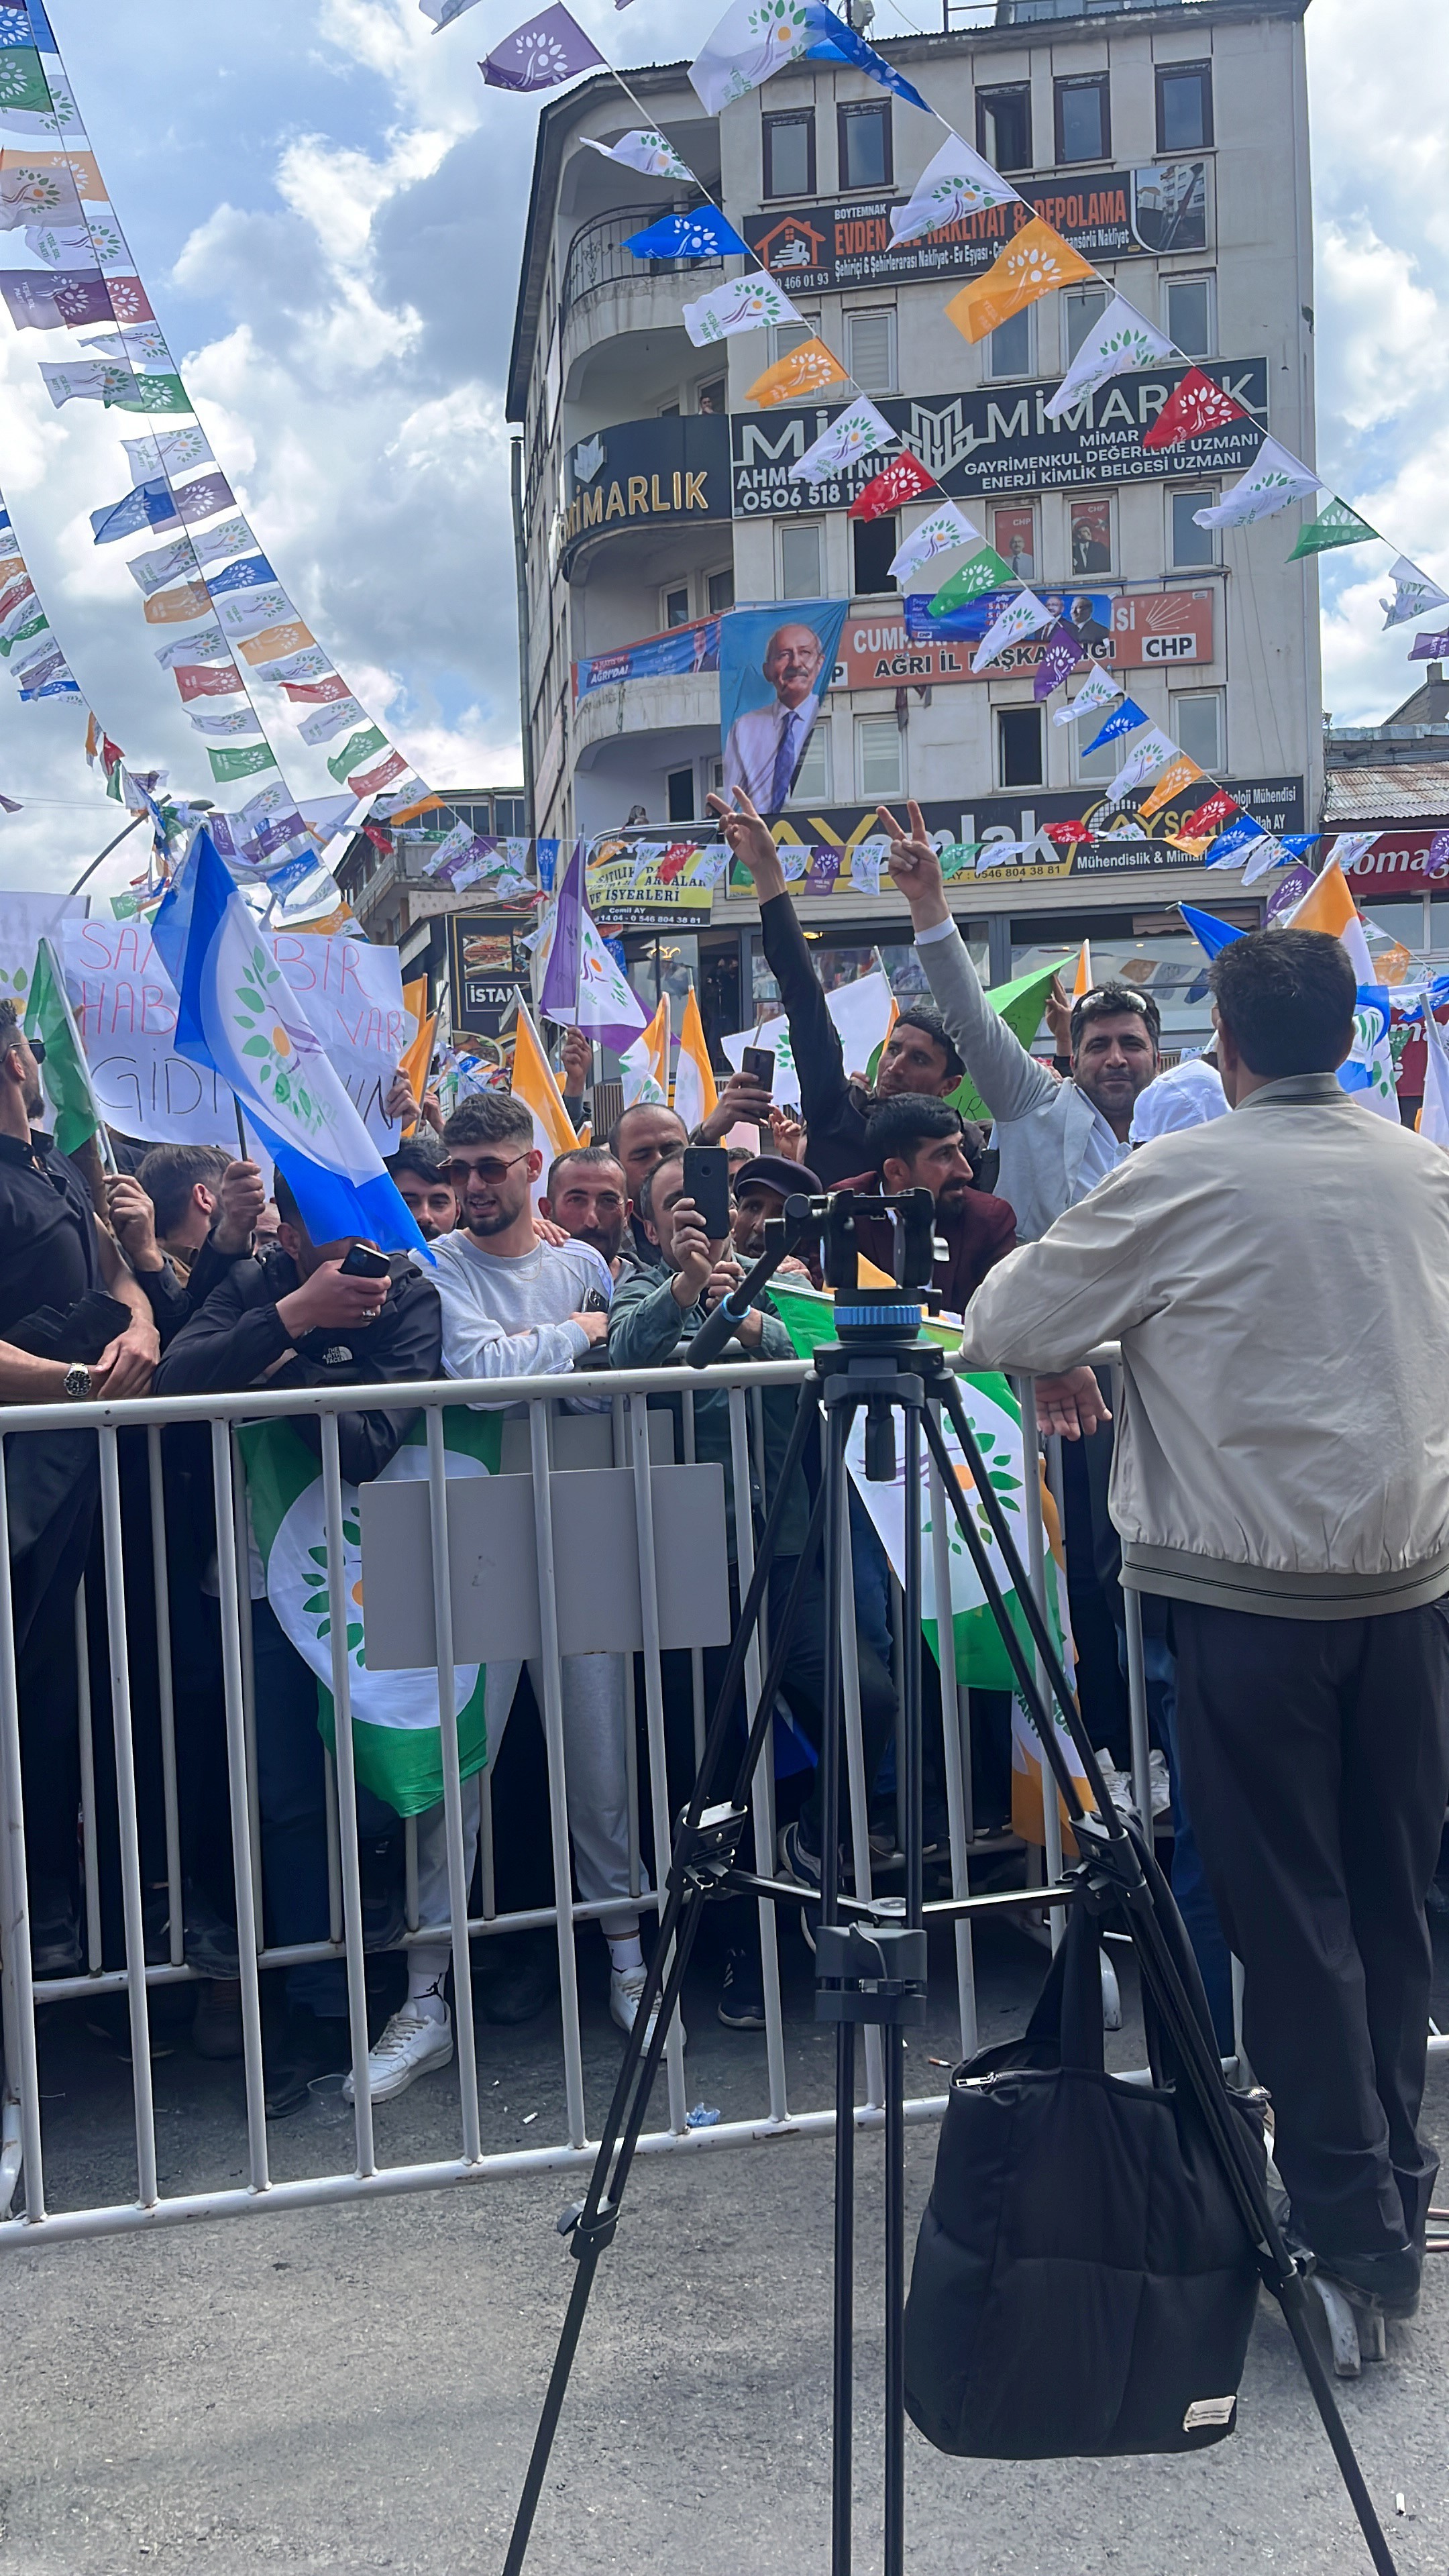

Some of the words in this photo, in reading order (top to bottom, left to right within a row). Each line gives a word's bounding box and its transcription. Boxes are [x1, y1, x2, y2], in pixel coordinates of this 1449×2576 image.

[835, 204, 887, 220] BOYTEMNAK
[835, 218, 887, 256] EVDEN
[918, 248, 949, 269] Nakliyat
[953, 246, 963, 263] Ev
[1098, 228, 1130, 249] Nakliyat
[784, 274, 801, 289] 466
[803, 274, 814, 288] 01
[817, 272, 829, 286] 93
[1079, 430, 1140, 448] MİMAR
[964, 453, 1081, 476] GAYRİMENKUL
[1191, 433, 1258, 452] UZMANI
[737, 466, 810, 490] AHME
[981, 471, 1036, 490] ENERJİ
[1040, 466, 1096, 484] KİMLİK
[1101, 457, 1169, 478] BELGESİ
[1174, 451, 1241, 470] UZMANI
[743, 487, 802, 511] 0506
[808, 483, 840, 505] 518
[1087, 505, 1105, 513] CHP
[1012, 517, 1031, 527] CHP
[1146, 637, 1193, 657] CHP
[874, 653, 932, 679] AĞRI
[940, 650, 962, 673] İL
[1253, 786, 1296, 804] Mühendisi
[1273, 814, 1285, 830] AY
[1077, 849, 1150, 869] Mühendislik
[1154, 851, 1163, 864] &
[1005, 867, 1026, 877] 804
[1030, 867, 1044, 875] 38
[1047, 865, 1061, 875] 81
[589, 892, 602, 905] VE
[273, 936, 374, 1000] BİR
[336, 1007, 402, 1052] VAR
